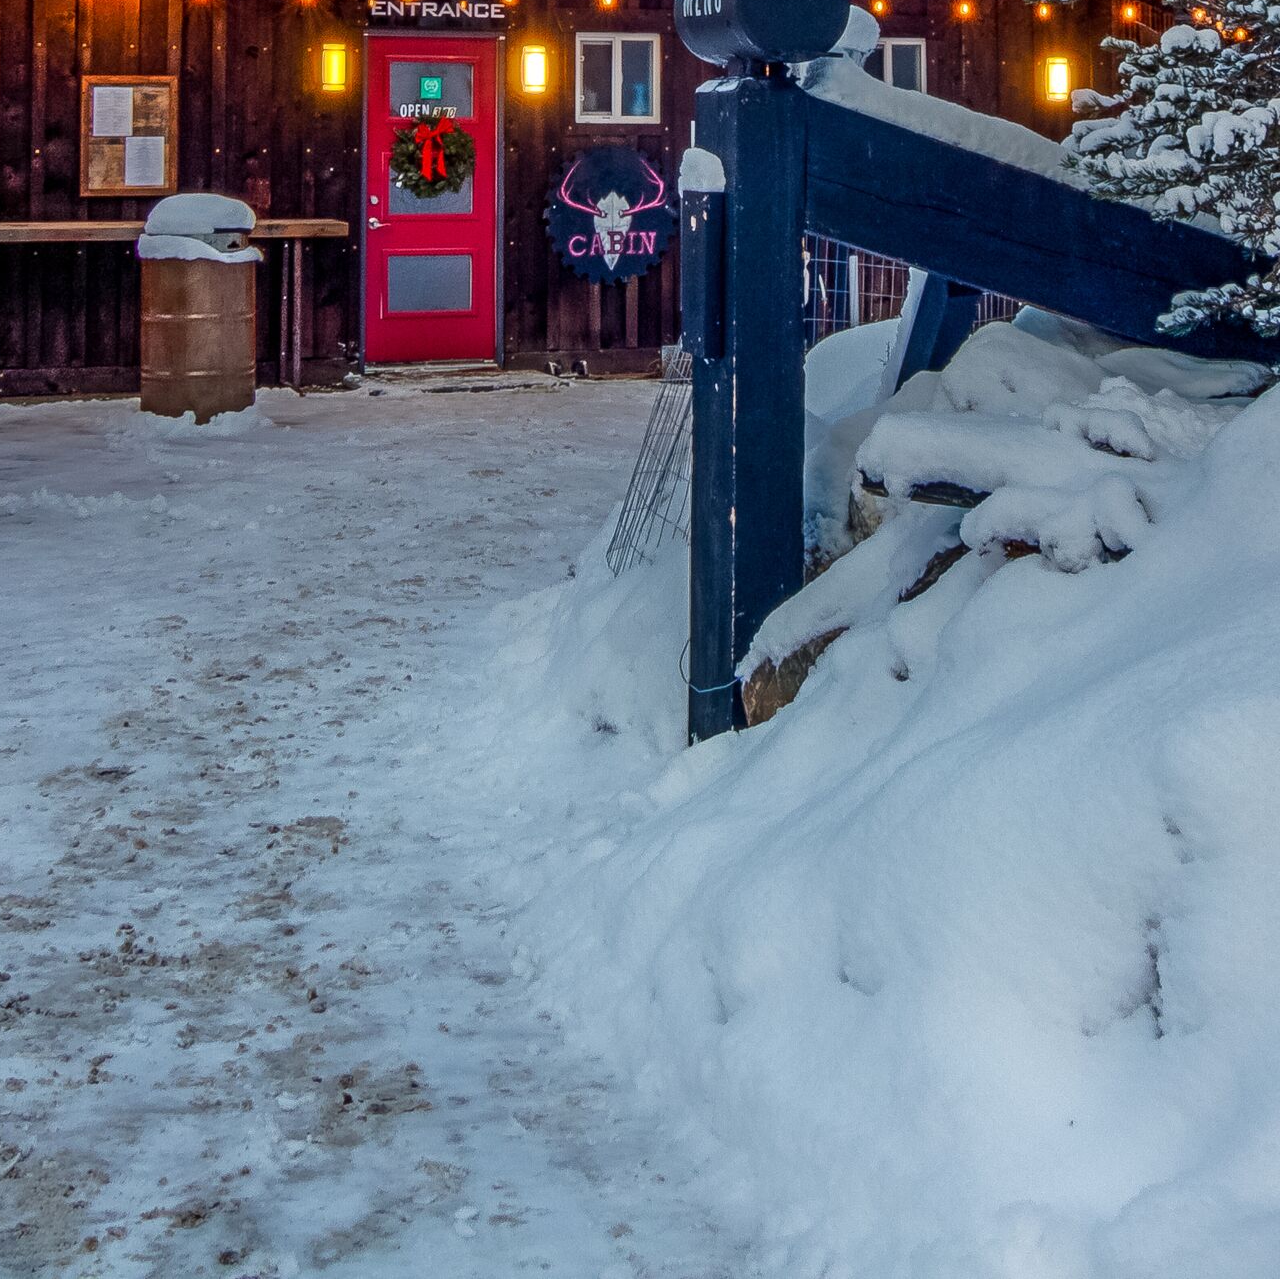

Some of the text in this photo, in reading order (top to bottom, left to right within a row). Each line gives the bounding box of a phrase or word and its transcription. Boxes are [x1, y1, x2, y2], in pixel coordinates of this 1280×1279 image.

[371, 0, 506, 19] ENTRANCE
[399, 103, 430, 118] OPEN
[568, 230, 657, 257] CABIN
